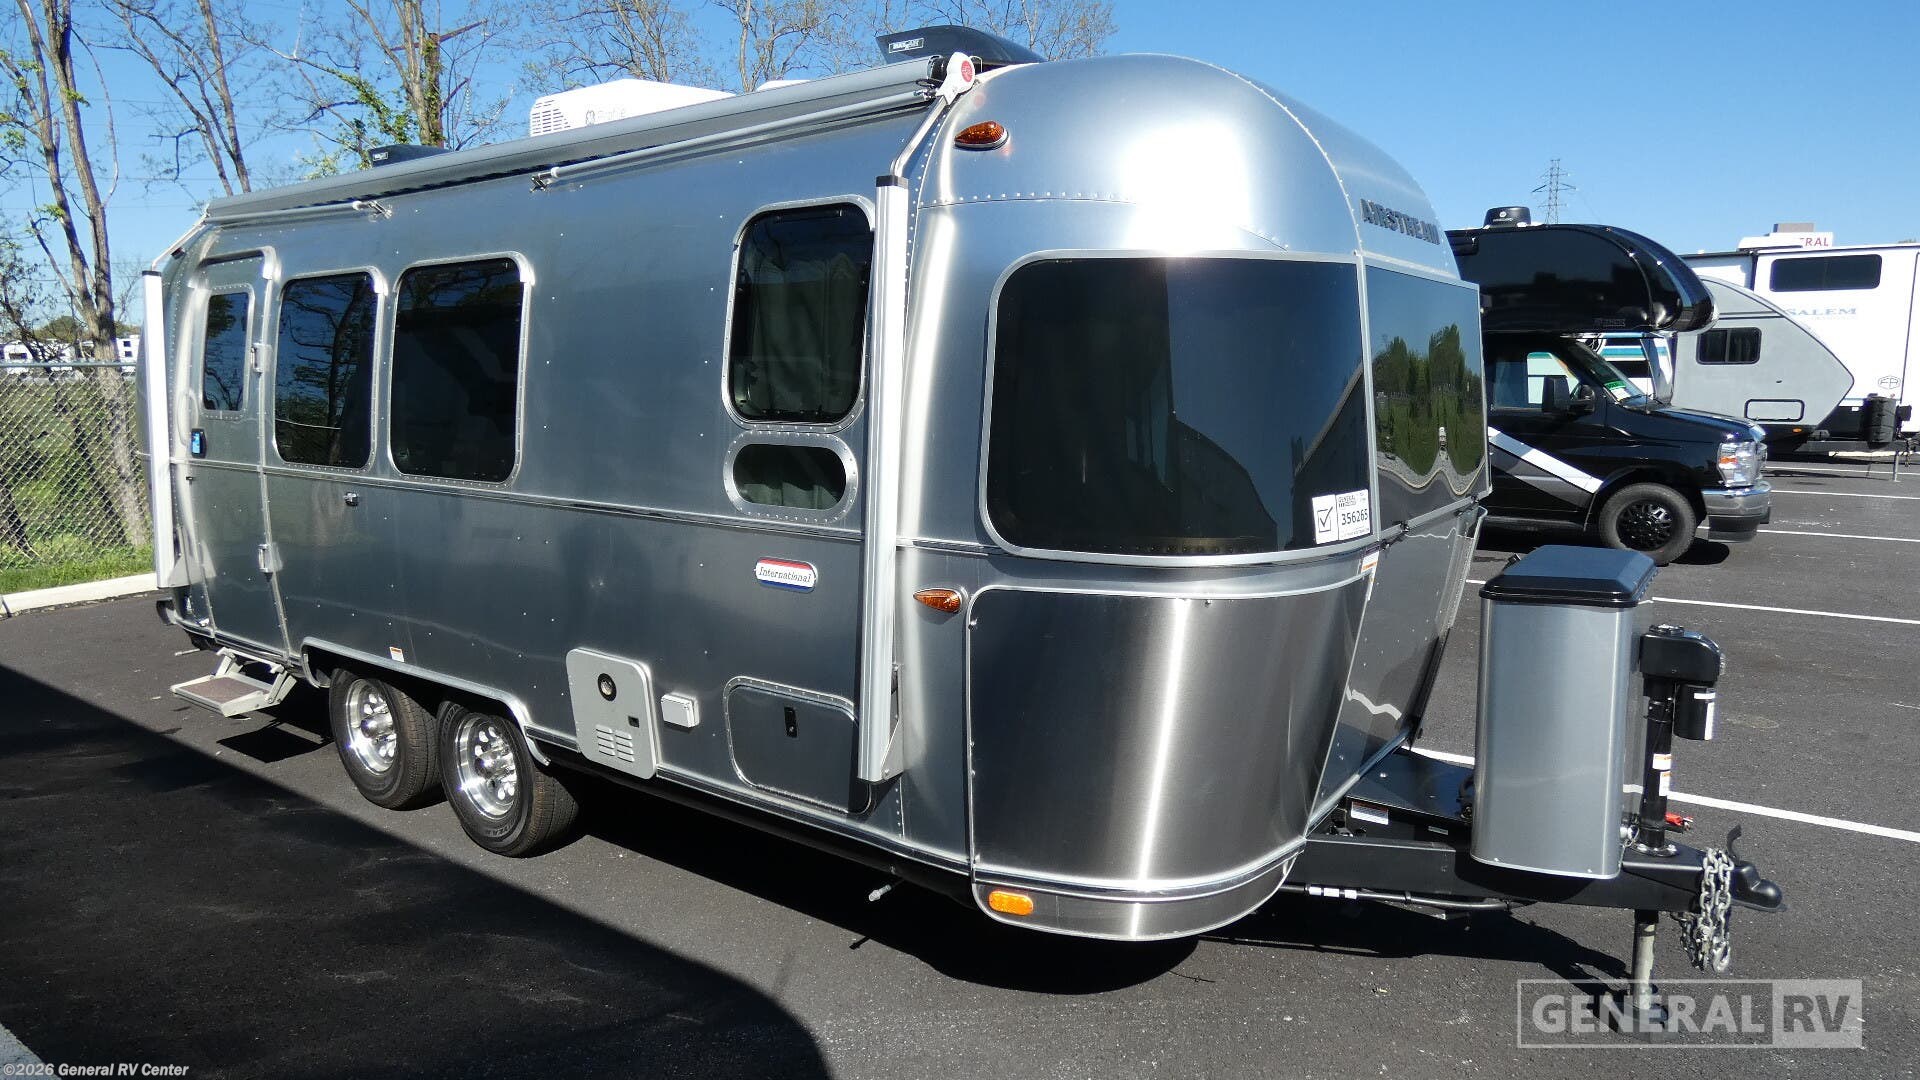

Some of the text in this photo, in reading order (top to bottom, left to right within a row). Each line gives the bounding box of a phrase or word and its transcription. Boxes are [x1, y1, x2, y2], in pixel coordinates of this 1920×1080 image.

[1360, 198, 1440, 245] AIRSTREAM
[1800, 237, 1829, 247] RAL
[1784, 307, 1857, 316] SALEM
[1341, 508, 1369, 526] 356265
[759, 566, 812, 583] International
